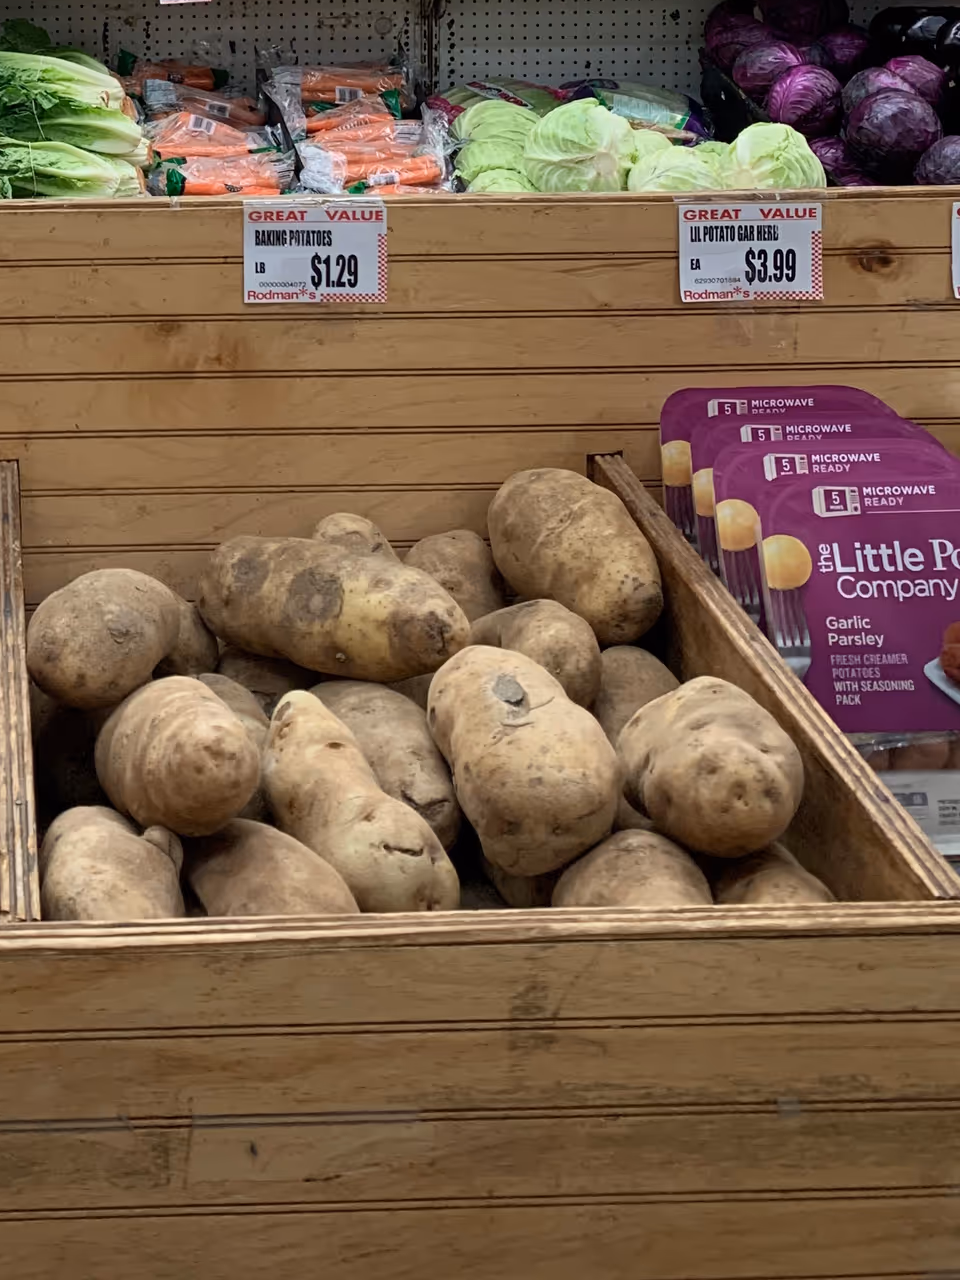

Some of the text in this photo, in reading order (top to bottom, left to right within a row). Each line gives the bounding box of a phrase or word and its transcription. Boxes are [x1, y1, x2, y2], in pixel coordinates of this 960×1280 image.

[248, 210, 384, 221] GREAT VALUE
[683, 208, 817, 220] GREAT VALUE
[255, 230, 332, 247] BAKING POTATOES
[690, 226, 702, 242] LIL
[703, 225, 735, 242] POTATO
[737, 225, 755, 242] GAR
[255, 262, 265, 274] LB
[690, 258, 701, 270] EA
[745, 247, 796, 286] $3.99
[310, 252, 358, 290] $1.29
[751, 398, 815, 408] MICROWAVE
[724, 404, 732, 415] 5
[785, 424, 852, 434] MICROWAVE
[757, 430, 765, 441] 5
[811, 453, 881, 463] MICROWAVE
[782, 459, 790, 471] 5
[812, 464, 851, 473] READY
[863, 485, 936, 496] MICROWAVE
[831, 492, 840, 505] 5
[865, 497, 904, 506] READY
[818, 543, 833, 573] the
[832, 540, 924, 573] Little
[837, 576, 958, 601] Company
[826, 616, 871, 629] Garlic
[828, 632, 884, 648] Parsley
[831, 654, 908, 665] FRESH CREAMER
[833, 668, 880, 678] POTATOES
[834, 680, 914, 692] WITH SEASONING
[836, 695, 861, 705] PACK
